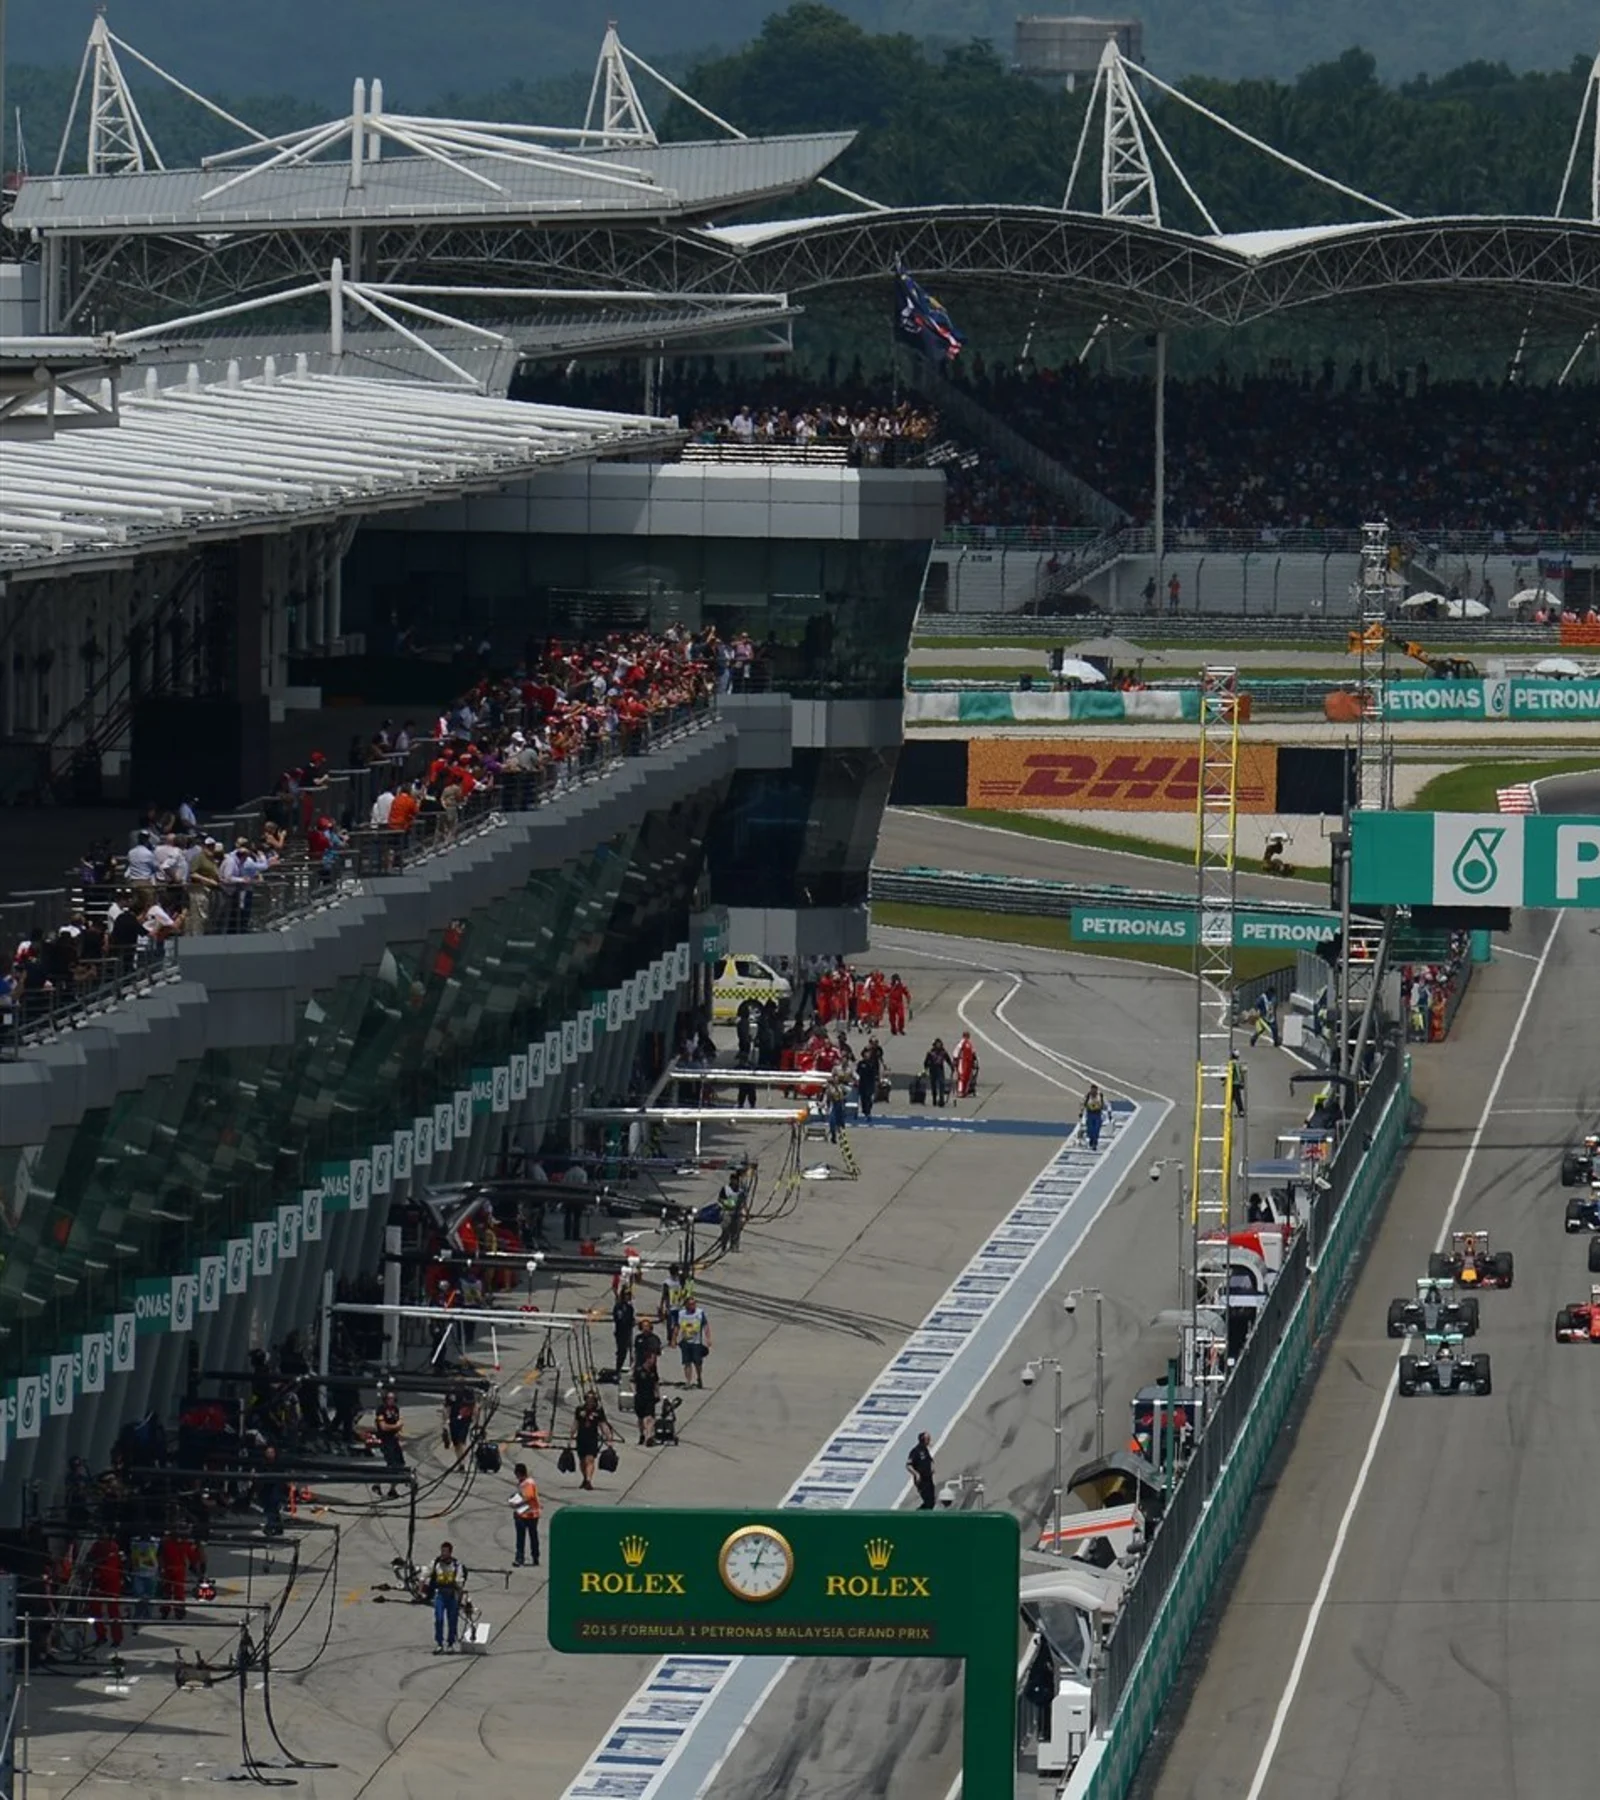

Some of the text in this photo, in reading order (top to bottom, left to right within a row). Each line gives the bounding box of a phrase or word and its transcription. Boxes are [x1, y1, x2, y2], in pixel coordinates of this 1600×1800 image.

[1018, 754, 1229, 799] DHL
[1082, 917, 1186, 937] PETRONAS
[1242, 922, 1341, 942] PETRONA
[581, 1573, 686, 1594] ROLEX
[826, 1575, 931, 1597] ROLEX
[582, 1624, 930, 1640] 2015 FORMULA 1 PETRONAS MALAYSIA GRAND PRIX
